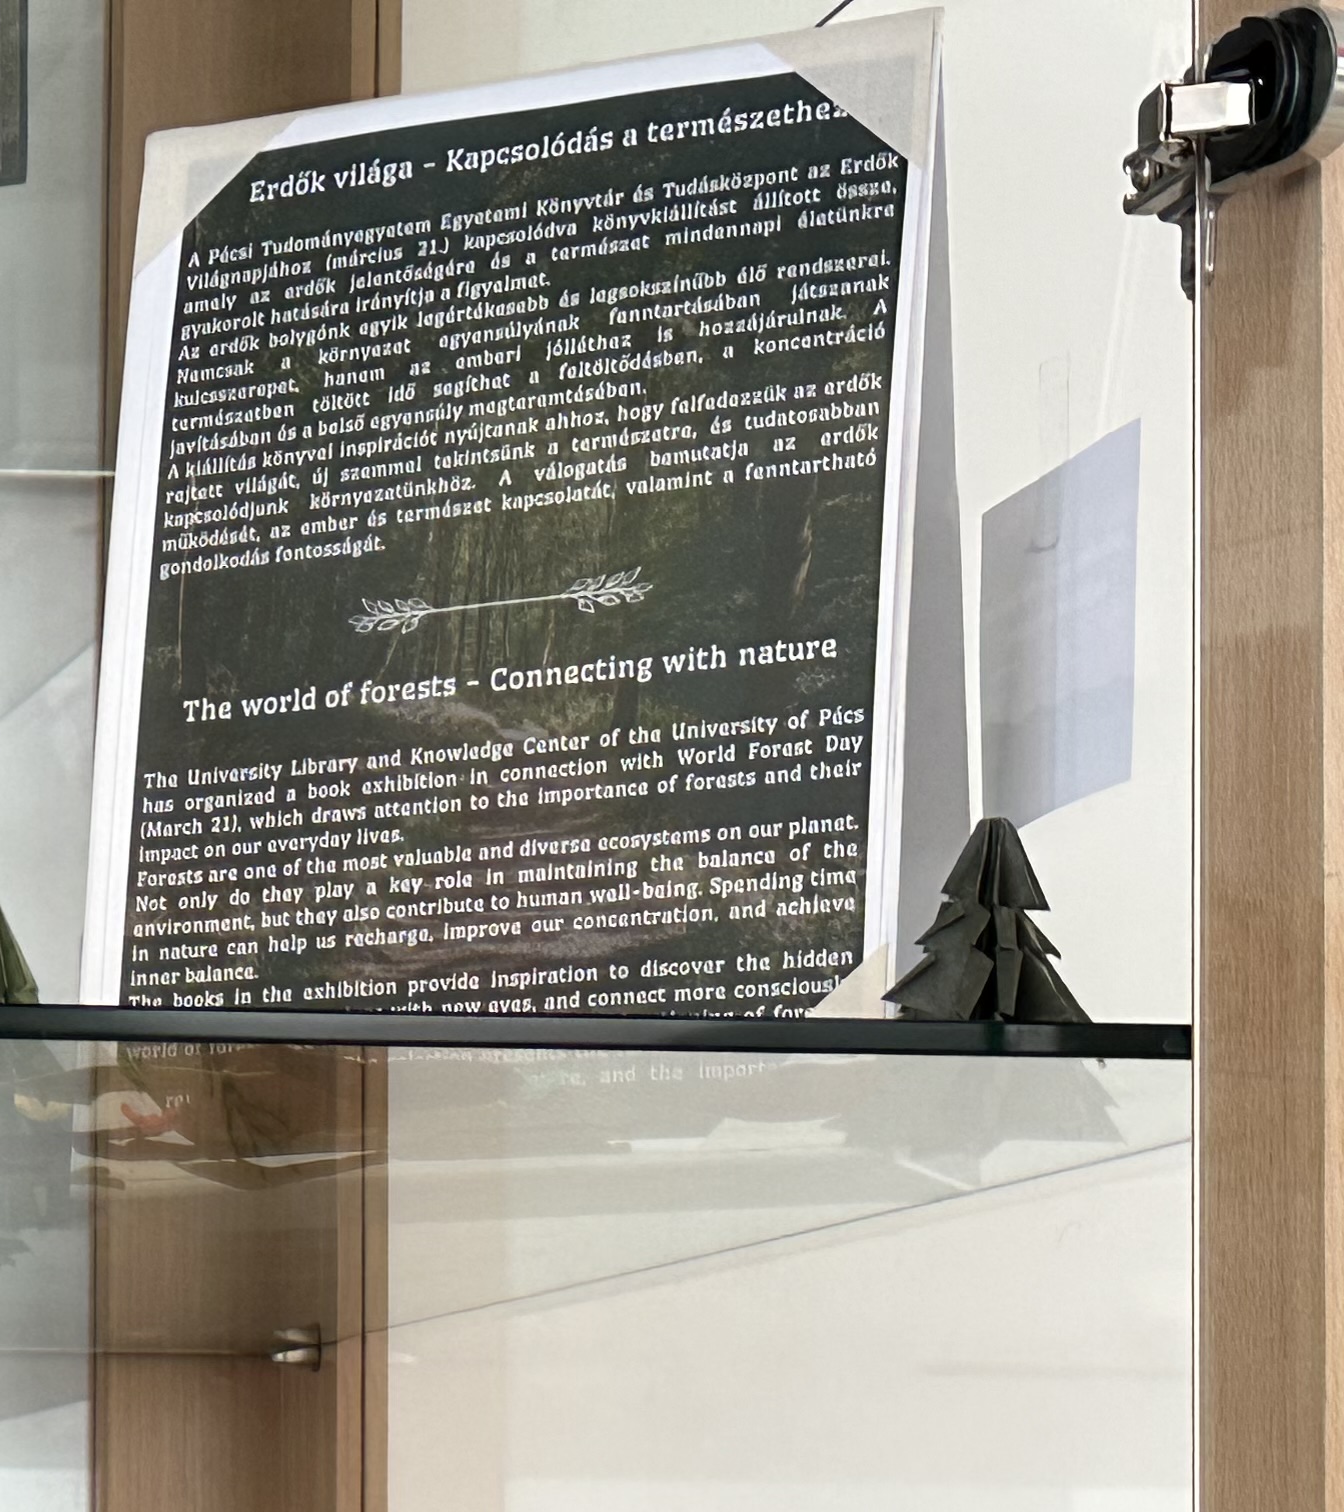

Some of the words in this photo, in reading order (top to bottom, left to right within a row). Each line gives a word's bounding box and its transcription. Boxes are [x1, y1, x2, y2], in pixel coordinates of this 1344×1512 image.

[248, 169, 326, 203] Erdők
[332, 156, 413, 189] világa
[444, 125, 614, 174] Kapcsolódás
[621, 127, 638, 148] a
[186, 250, 200, 269] A
[207, 241, 253, 265] Pécsi
[439, 200, 527, 233] Egyetemi
[535, 186, 625, 217] Könyvtár
[631, 182, 654, 203] és
[806, 163, 831, 180] az
[839, 151, 898, 175] Erdők
[179, 309, 265, 342] gyakorolt
[269, 298, 350, 325] hatására
[354, 286, 435, 313] irányítja
[439, 286, 451, 301] a
[455, 271, 551, 301] figyelmet.
[161, 524, 261, 553] működését,
[268, 523, 291, 539] az
[299, 514, 359, 536] ember
[366, 508, 387, 528] és
[395, 496, 492, 524] természet
[624, 469, 713, 495] valamint
[722, 468, 734, 484] a
[158, 546, 270, 581] gondolkodás
[181, 696, 232, 723] The
[239, 684, 317, 717] world
[323, 680, 353, 709] of
[359, 674, 457, 705] forests
[489, 654, 653, 692] Connecting
[661, 643, 727, 674] with
[737, 637, 837, 667] nature
[141, 795, 174, 814] has
[183, 784, 275, 814] organized
[285, 787, 297, 803] a
[307, 778, 351, 800] book
[360, 770, 458, 795] exhibition
[469, 767, 489, 785] in
[499, 756, 608, 783] connection
[619, 749, 664, 772] with
[676, 742, 736, 766] World
[747, 737, 813, 760] Forest
[824, 733, 864, 754] Day
[142, 770, 178, 789] The
[186, 761, 283, 786] University
[289, 755, 359, 777] Library
[365, 747, 402, 770] and
[409, 739, 514, 766] Knowledge
[522, 734, 590, 755] Center
[598, 726, 621, 748] of
[627, 724, 662, 745] the
[671, 715, 779, 741] University
[786, 708, 810, 730] of
[817, 704, 865, 727] Pécs
[139, 816, 203, 840] (March
[210, 812, 242, 833] 21),
[248, 807, 303, 830] which
[310, 804, 367, 824] draws
[373, 795, 462, 819] attention
[469, 793, 490, 811] to
[496, 788, 529, 808] the
[537, 780, 649, 807] importance
[656, 772, 679, 794] of
[684, 770, 756, 792] forests
[763, 762, 802, 785] and
[809, 758, 862, 781] their
[135, 868, 204, 888] Forests
[207, 866, 238, 883] are
[242, 863, 277, 880] one
[281, 856, 303, 877] of
[305, 855, 336, 875] the
[342, 852, 388, 872] most
[392, 843, 472, 868] valuable
[477, 839, 514, 861] and
[518, 837, 591, 857] diverse
[596, 827, 711, 851] ecosystems
[715, 824, 742, 841] on
[747, 821, 783, 839] our
[787, 813, 859, 840] planet.
[138, 843, 199, 866] impact
[202, 842, 226, 858] on
[230, 839, 262, 856] our
[266, 829, 352, 853] everyday
[355, 826, 405, 845] lives.
[127, 993, 162, 1007] The
[172, 989, 224, 1007] books
[233, 986, 252, 1006] in
[261, 984, 292, 1003] the
[301, 977, 397, 1001] exhibition
[406, 970, 480, 998] provide
[489, 964, 598, 991] inspiration
[608, 963, 629, 980] to
[639, 958, 726, 978] discover
[735, 952, 771, 972] the
[781, 947, 853, 970] hidden
[129, 969, 181, 987] inner
[184, 964, 259, 984] balance.
[543, 989, 581, 1010] and
[586, 987, 666, 1007] connect
[673, 984, 726, 1002] more
[732, 974, 841, 999] consciousl
